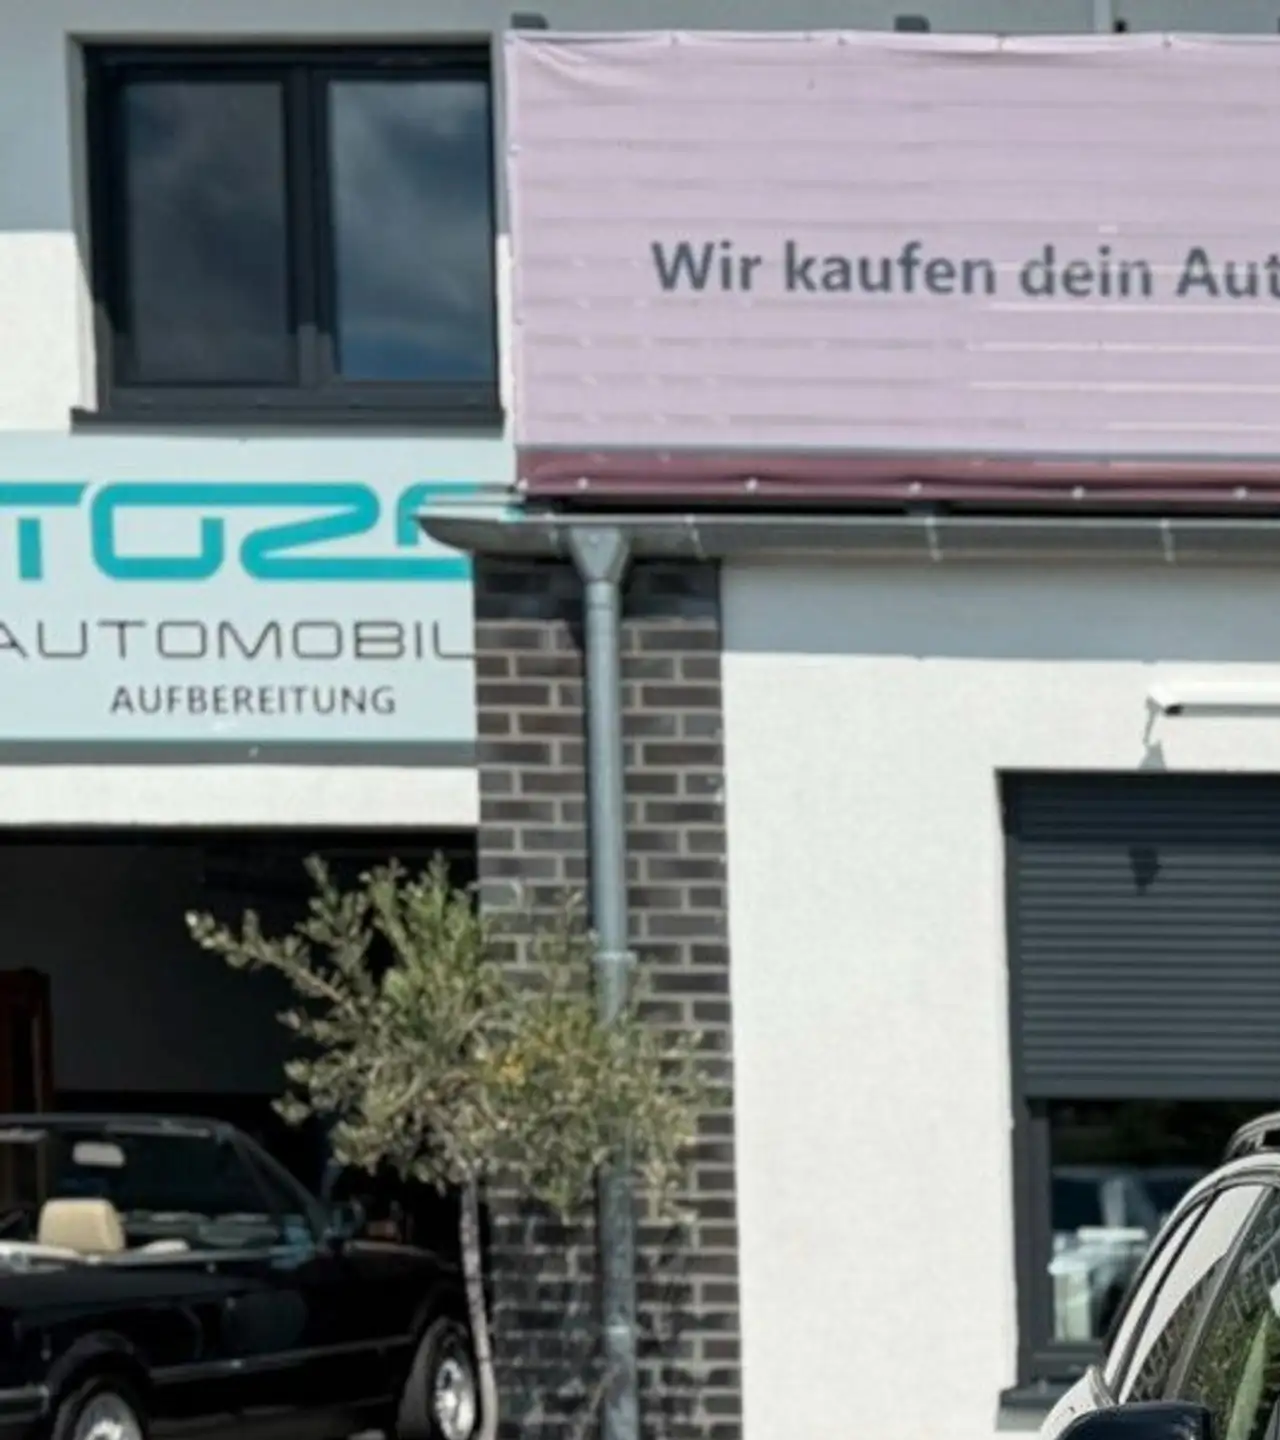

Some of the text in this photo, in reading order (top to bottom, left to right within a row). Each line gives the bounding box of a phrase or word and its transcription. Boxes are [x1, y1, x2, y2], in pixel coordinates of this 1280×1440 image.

[650, 240, 762, 292] Wir
[784, 240, 997, 297] kaufen
[1018, 244, 1153, 299] dein
[109, 685, 398, 716] AUFBEREITUNG
